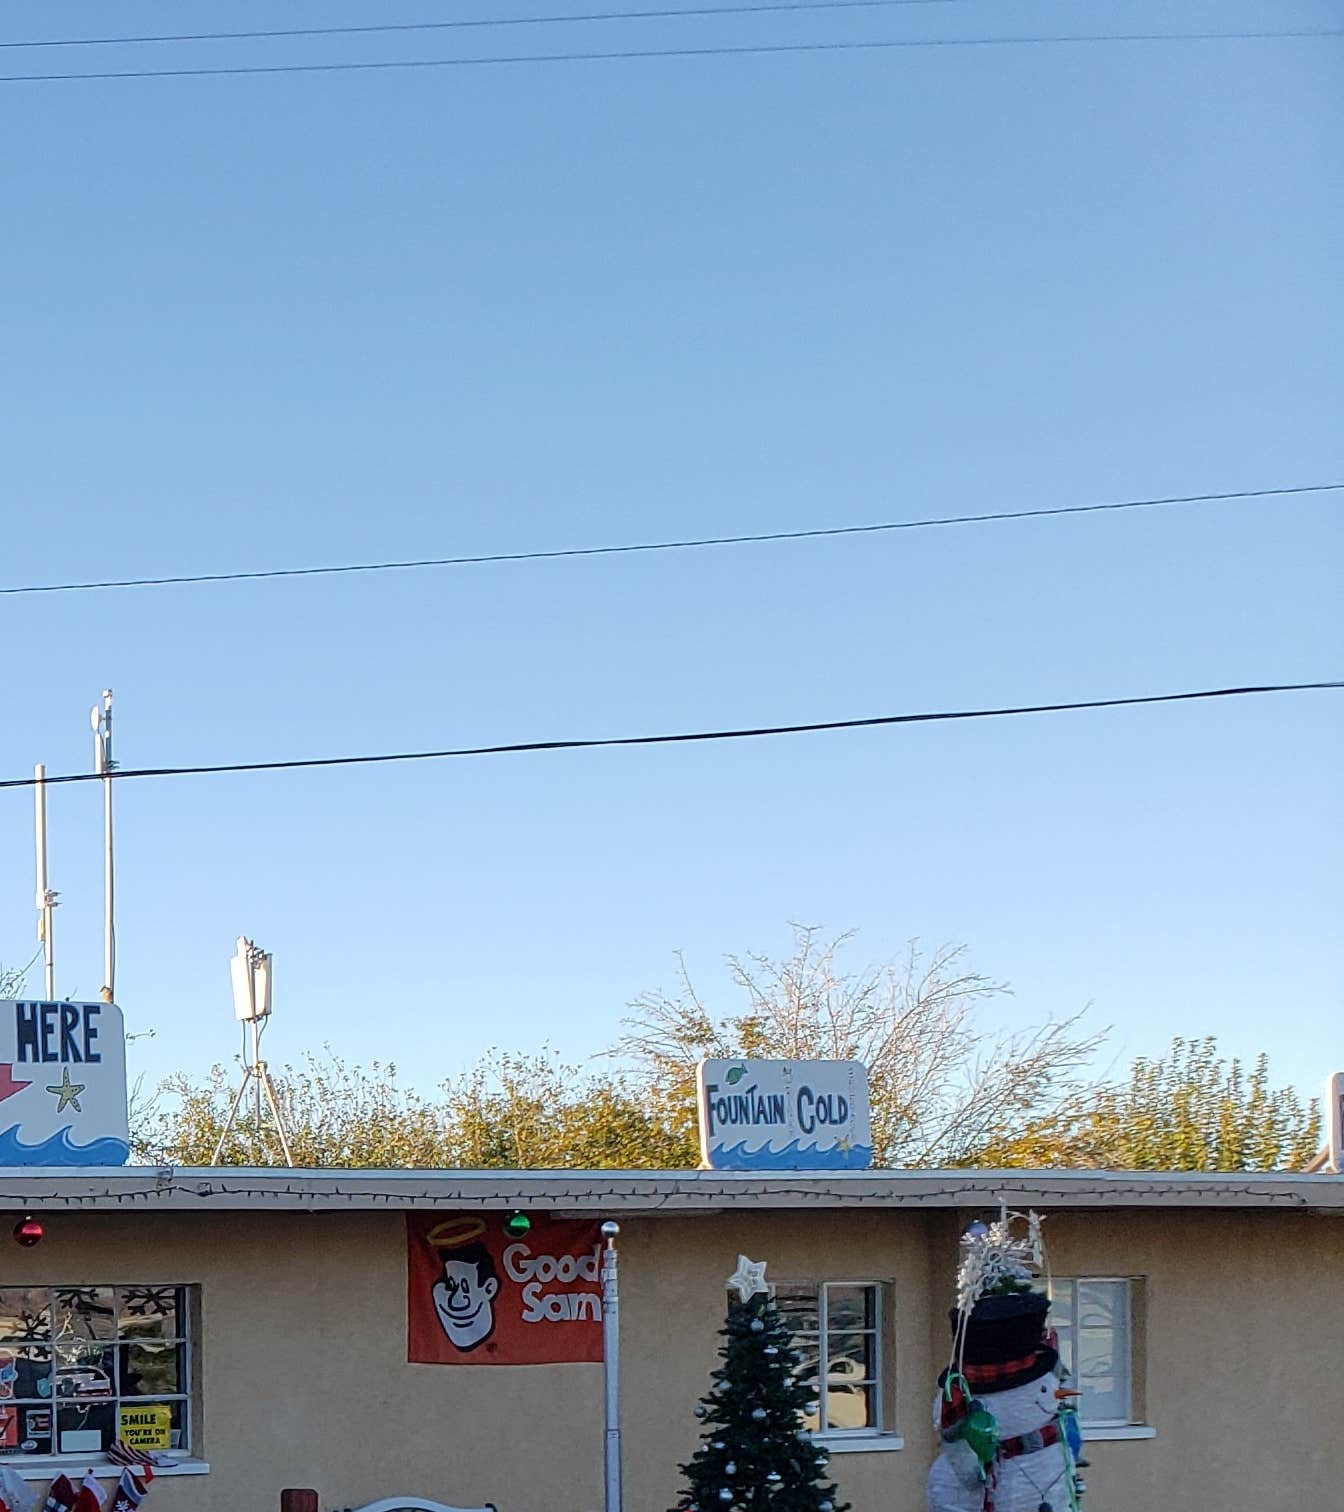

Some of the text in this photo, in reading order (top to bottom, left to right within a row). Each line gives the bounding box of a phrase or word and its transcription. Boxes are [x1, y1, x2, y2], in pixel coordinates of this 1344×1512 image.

[16, 1002, 102, 1063] HERE
[706, 1084, 849, 1137] FOUNTAIN COLD
[503, 1243, 601, 1283] Good
[522, 1282, 603, 1322] Sam
[120, 1414, 157, 1425] SMILE
[129, 1437, 161, 1445] CAMERA
